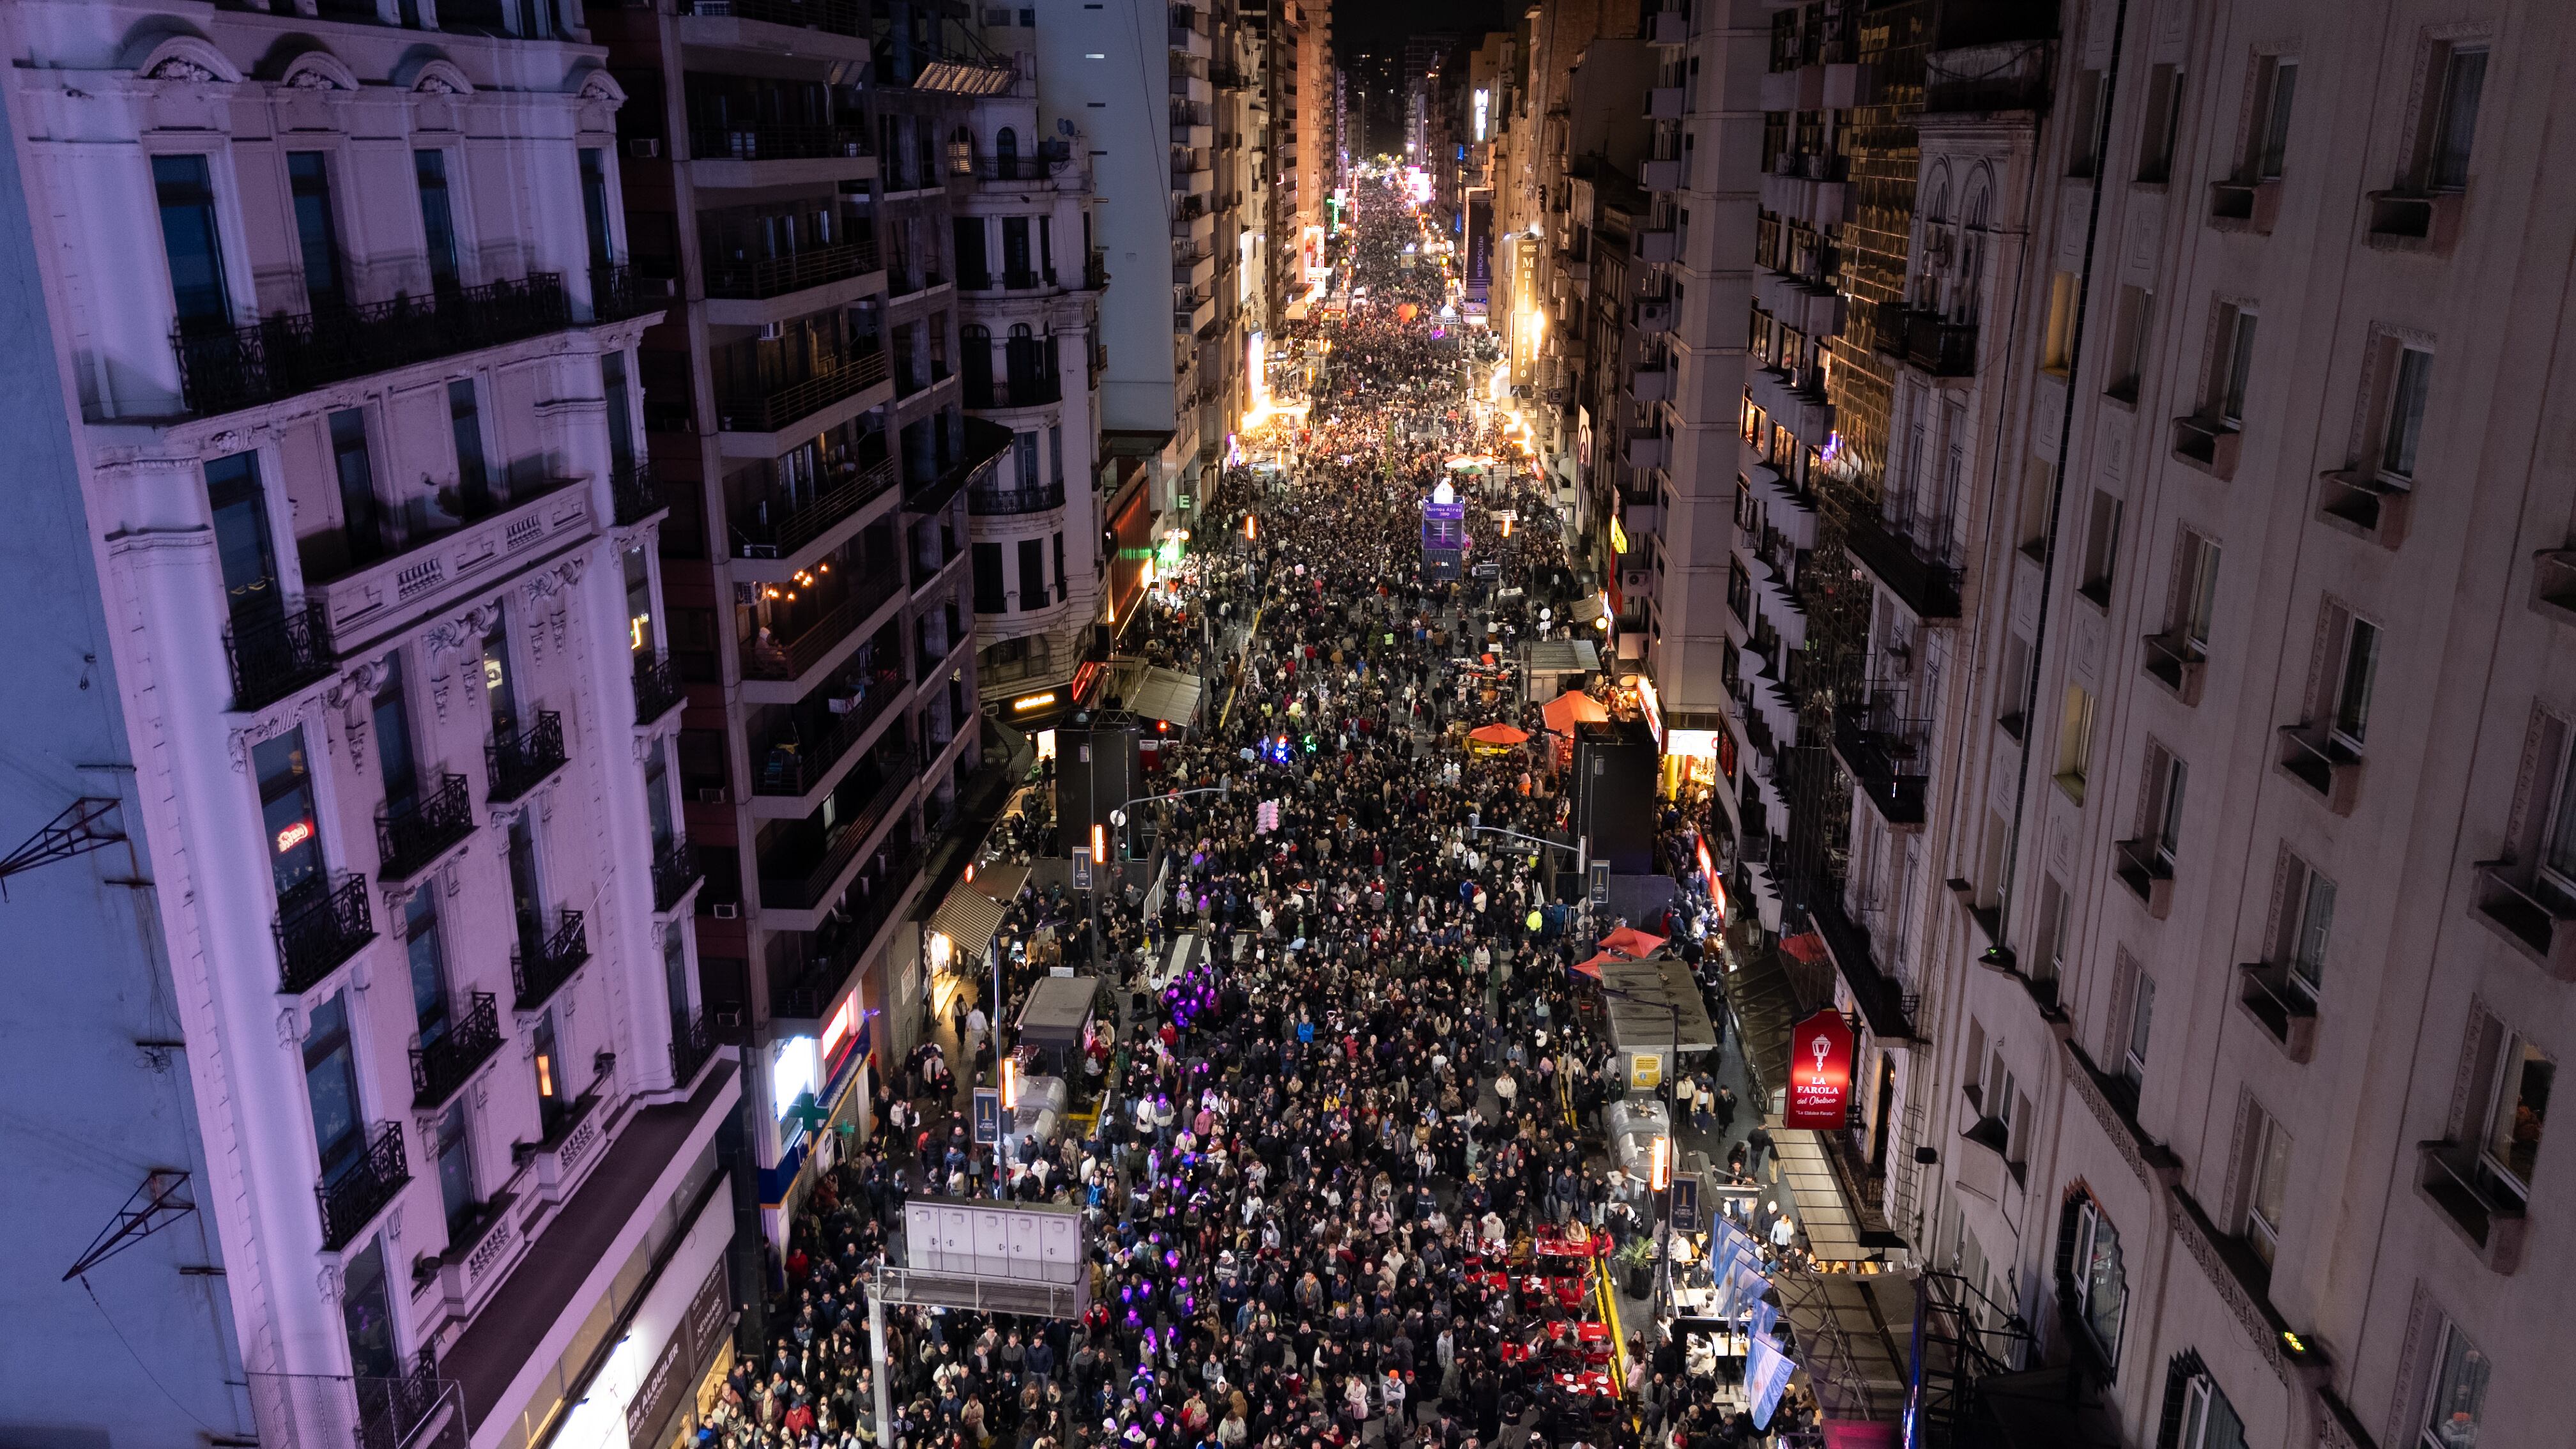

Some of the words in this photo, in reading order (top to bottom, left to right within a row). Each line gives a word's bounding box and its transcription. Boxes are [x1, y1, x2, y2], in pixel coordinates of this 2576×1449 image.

[1179, 495, 1190, 509] E
[1812, 1076, 1826, 1085] LA
[1797, 1085, 1839, 1094] FAROLA
[1809, 1096, 1837, 1106] Obelisco
[697, 1293, 721, 1337] NEWMARK
[629, 1405, 641, 1431] EN
[642, 1342, 678, 1411] ALQUILER
[630, 1419, 645, 1443] hasta
